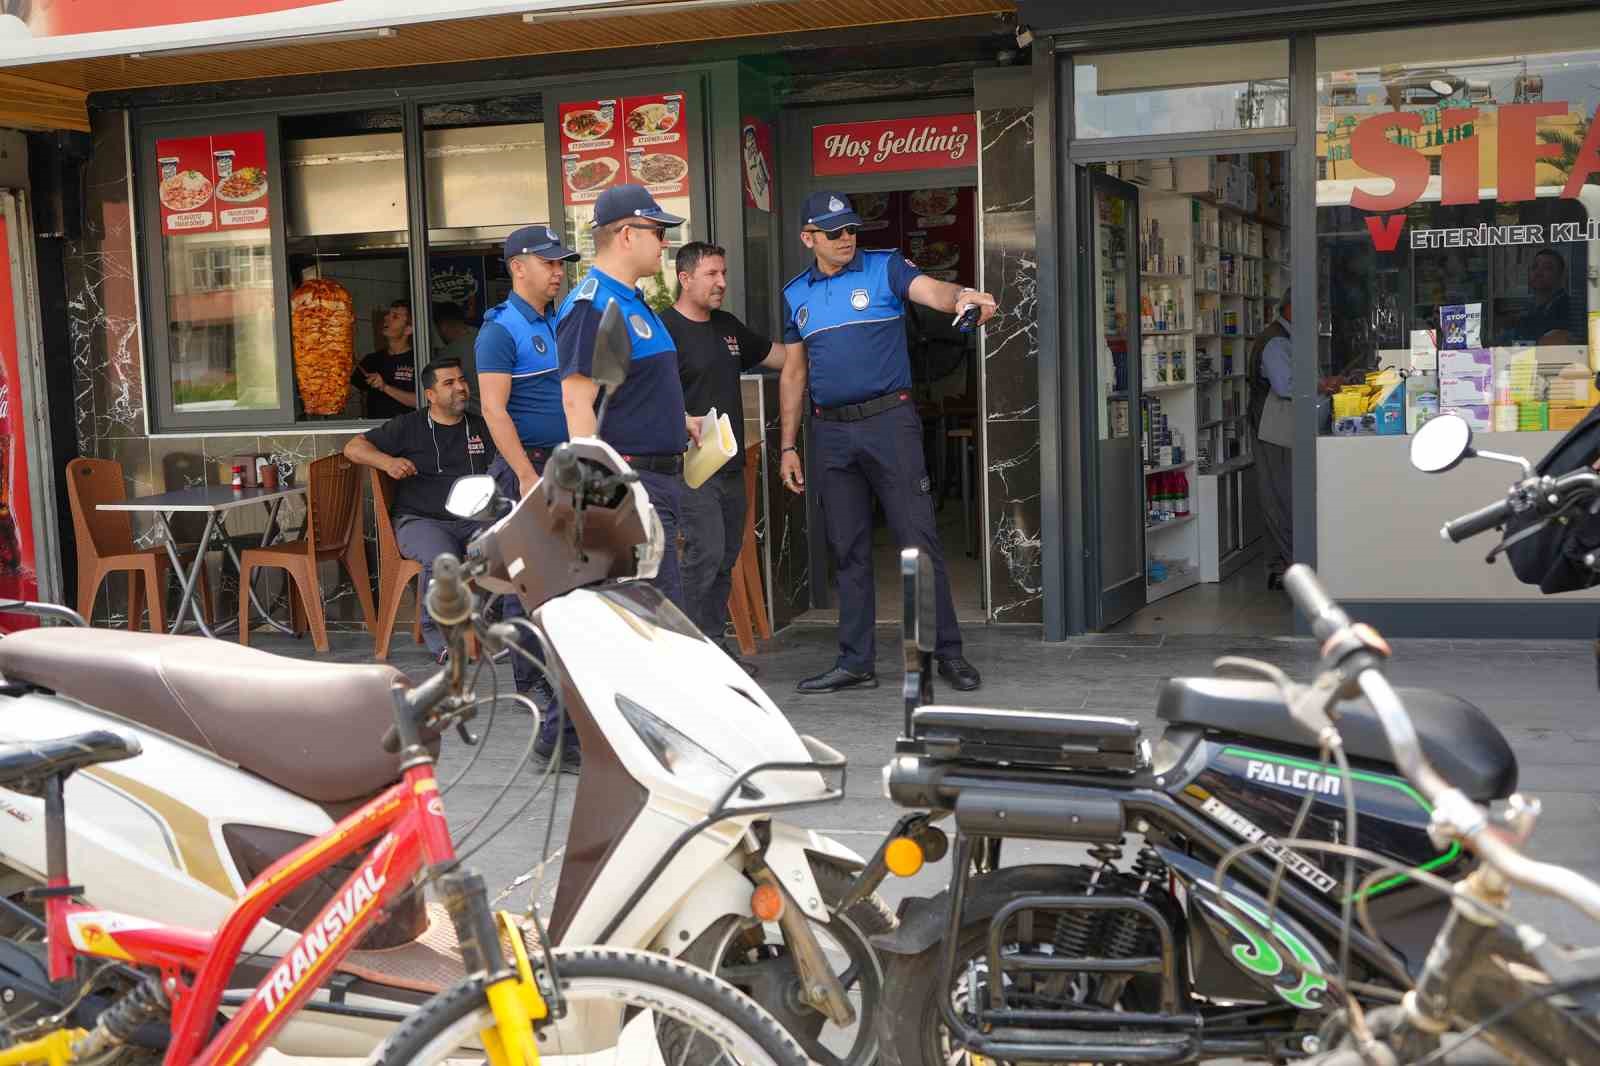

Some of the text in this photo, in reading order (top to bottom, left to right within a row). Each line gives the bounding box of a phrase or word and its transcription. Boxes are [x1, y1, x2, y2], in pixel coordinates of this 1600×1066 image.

[824, 126, 969, 166] Hoş Geldiniz
[1550, 217, 1600, 243] KLİ
[1246, 760, 1341, 795] FALCON
[256, 867, 387, 1013] TRANSVAL
